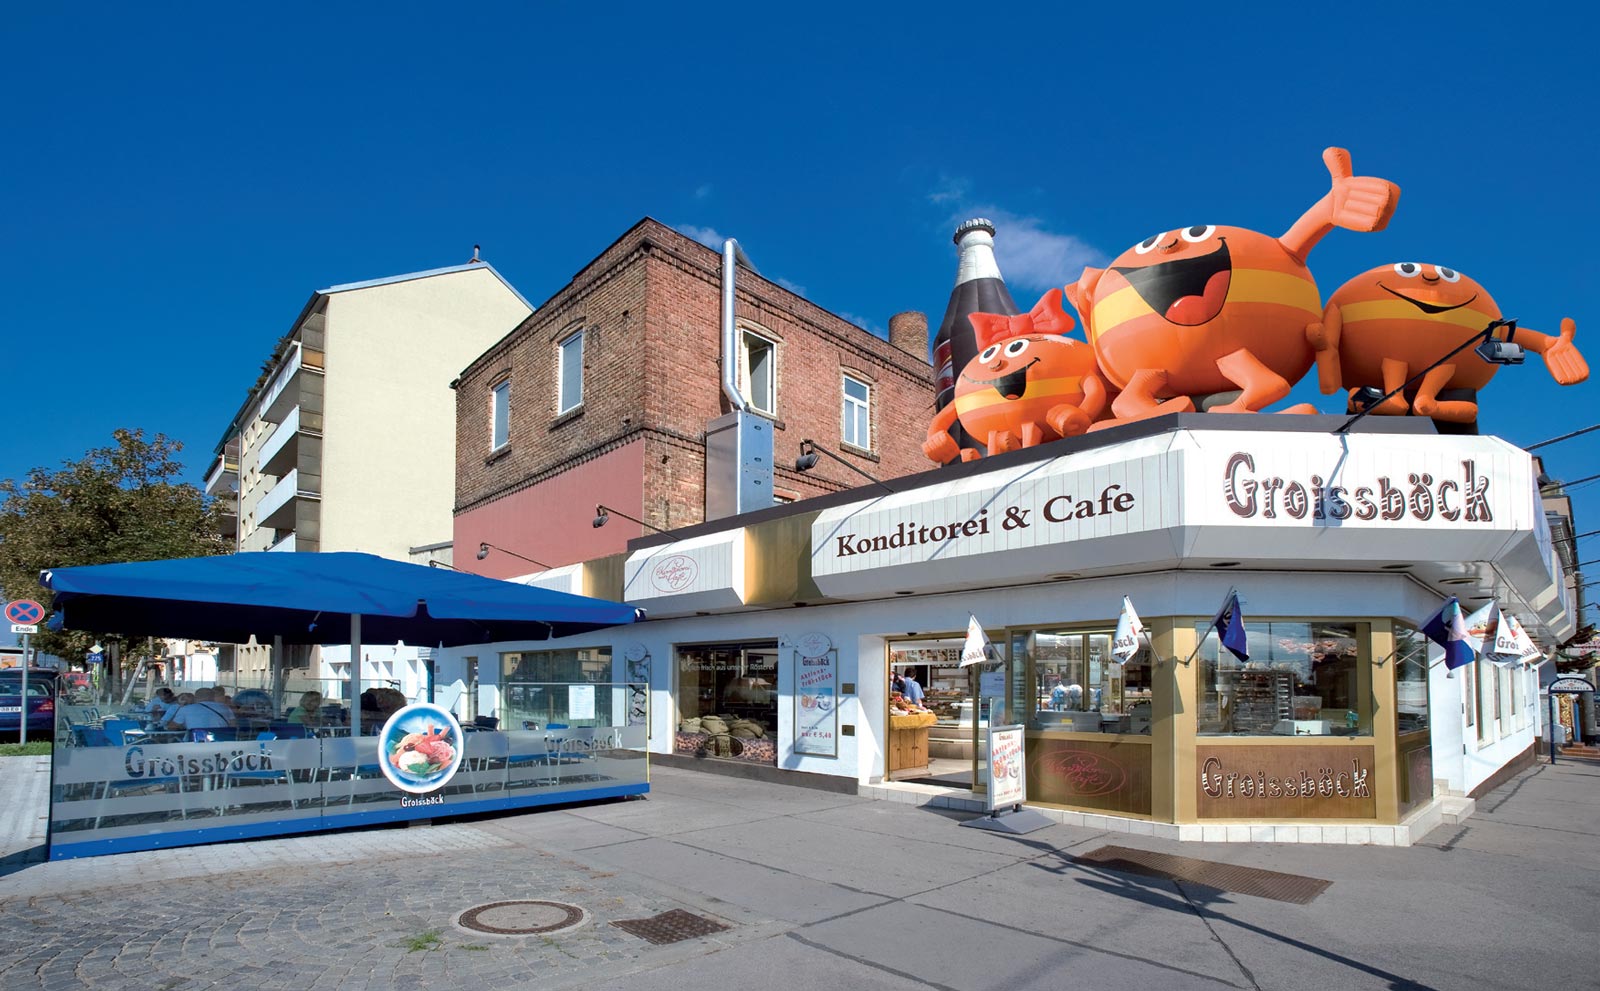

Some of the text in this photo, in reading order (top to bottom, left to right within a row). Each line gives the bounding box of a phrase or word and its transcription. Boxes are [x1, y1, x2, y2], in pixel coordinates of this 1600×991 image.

[1223, 452, 1493, 522] Groissböck
[837, 484, 1135, 557] Konditorei & Cafe
[124, 742, 273, 778] Groissböck
[1201, 756, 1371, 798] Groissböck
[400, 794, 444, 808] Groissböck
